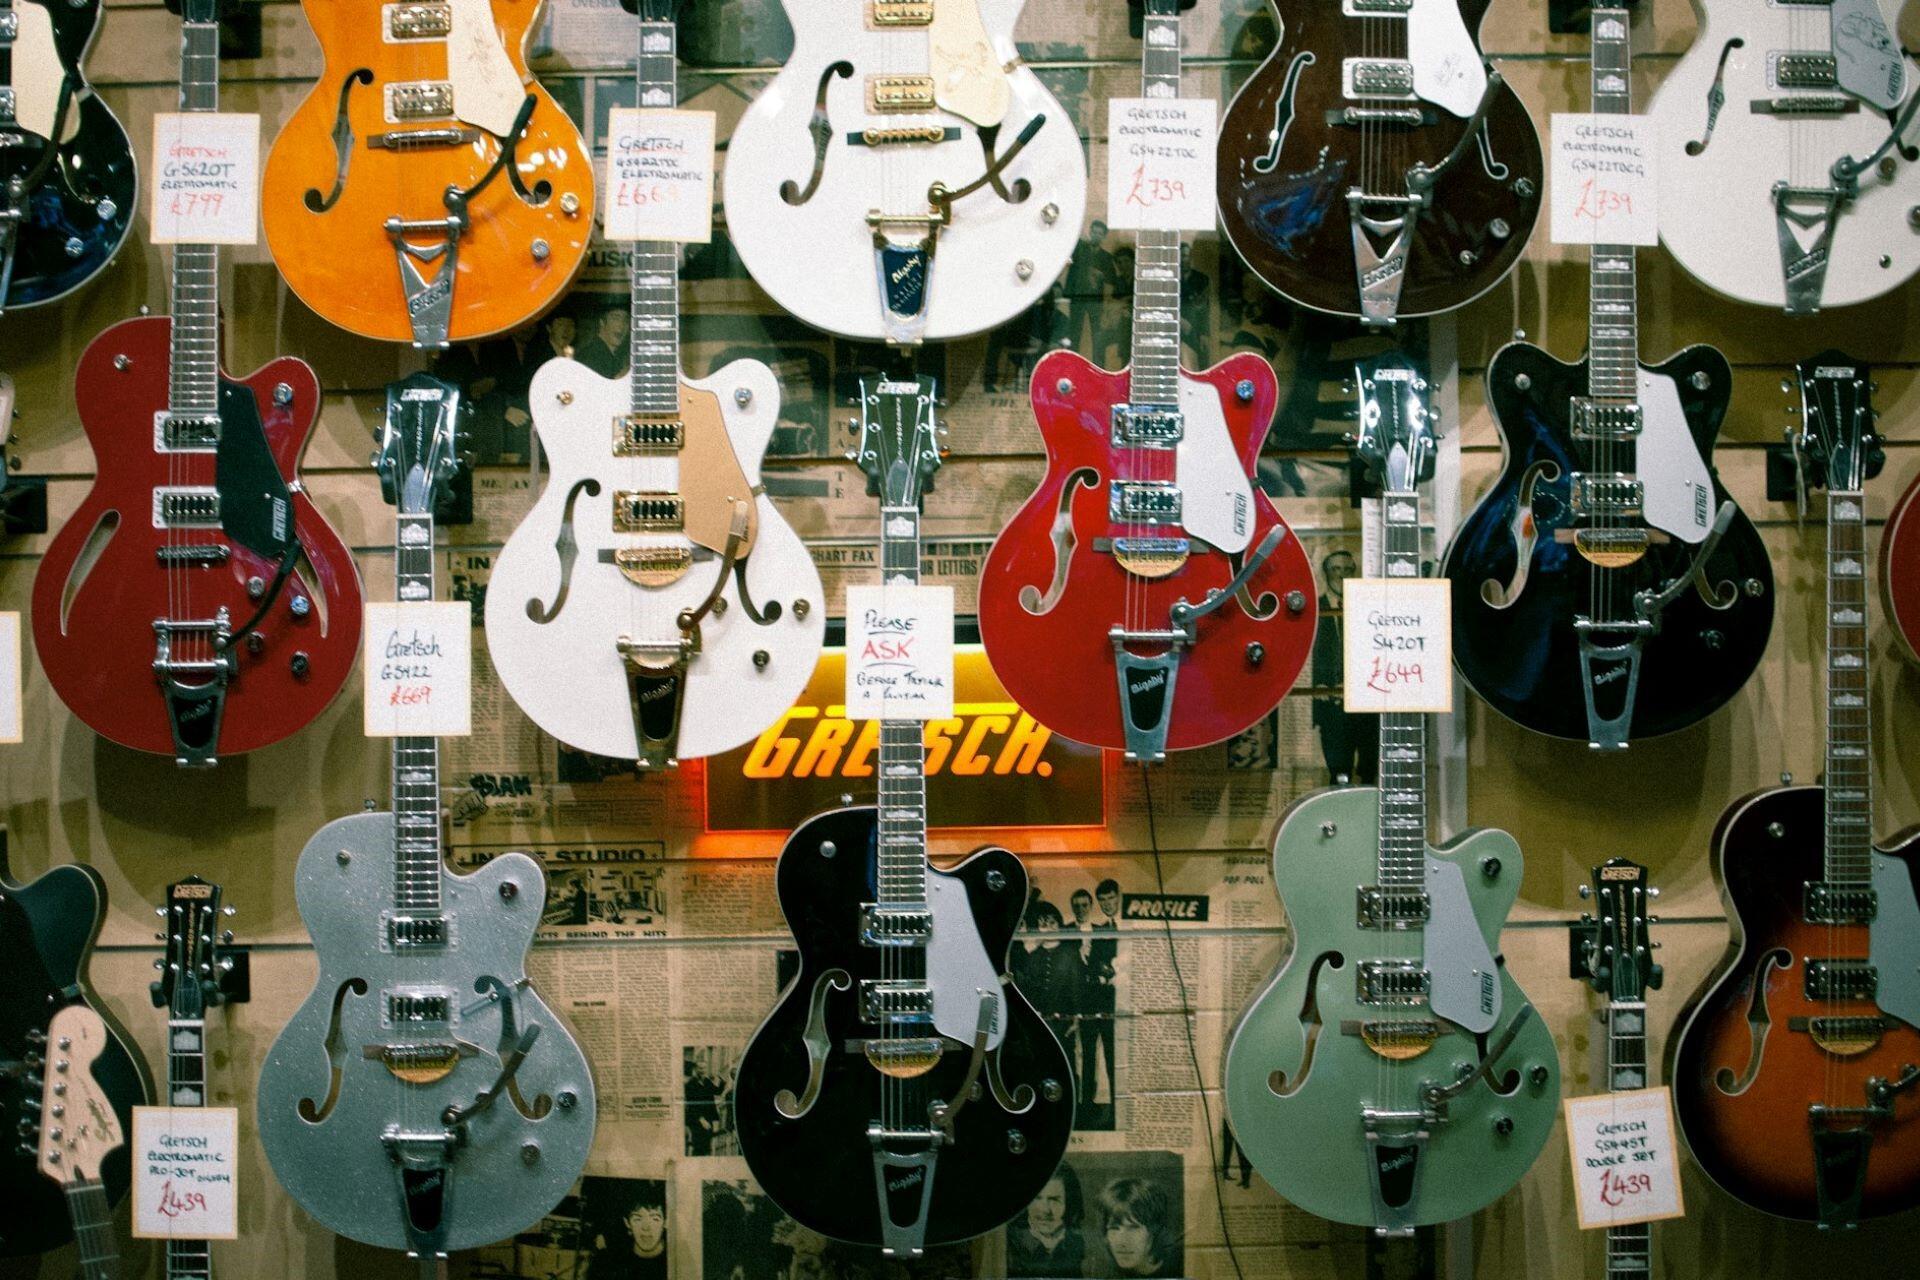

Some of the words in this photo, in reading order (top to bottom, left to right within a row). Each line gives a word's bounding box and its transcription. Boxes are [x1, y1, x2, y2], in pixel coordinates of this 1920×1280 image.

[1575, 125, 1634, 140] GRETSCH
[1126, 162, 1186, 207] £739
[170, 191, 224, 218] £799
[1233, 492, 1248, 537] GRETSCH
[851, 550, 875, 562] FAX
[937, 560, 977, 576] LETTERS
[1368, 610, 1422, 629] GRETSCH
[862, 637, 915, 659] ASK
[1131, 670, 1164, 695] Bigsby
[1367, 656, 1424, 693] £649
[743, 702, 1053, 778] GRESCH.
[1127, 899, 1199, 918] PROFILE
[1480, 970, 1495, 1016] GRETSCH
[1596, 1121, 1648, 1135] GRETSCH
[160, 1134, 207, 1149] GRETSCH
[158, 1180, 207, 1217] £439
[1600, 1169, 1652, 1207] £439
